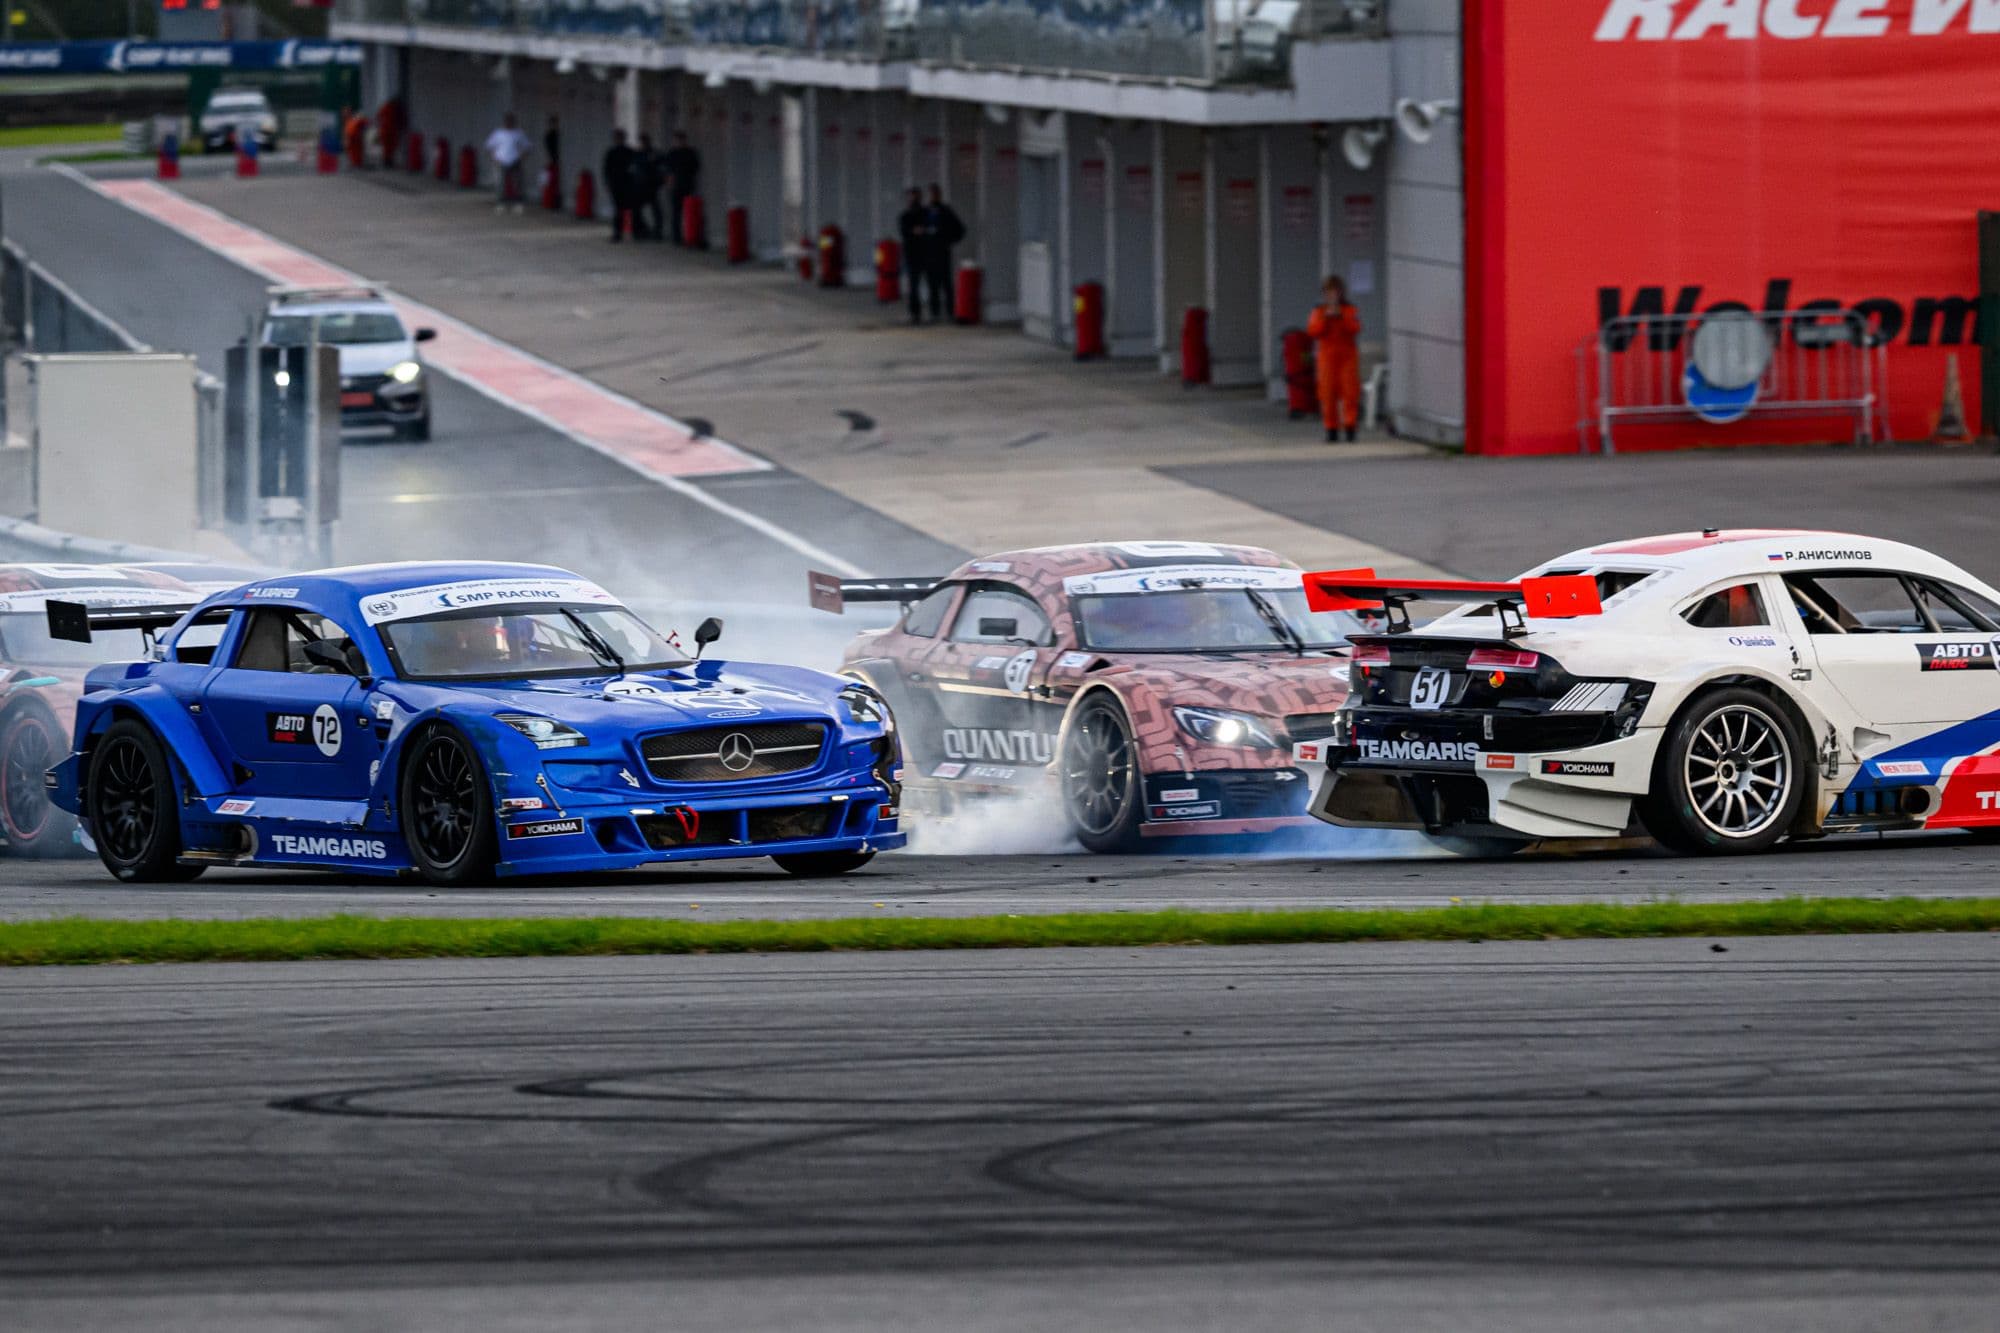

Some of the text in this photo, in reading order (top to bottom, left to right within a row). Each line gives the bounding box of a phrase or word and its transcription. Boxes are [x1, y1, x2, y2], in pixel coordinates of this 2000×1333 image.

[1597, 278, 1981, 353] Wlcom
[1785, 551, 1873, 561] Р.АНИСИМОВ
[457, 589, 561, 604] SMP RACING
[1933, 644, 1985, 658] АВТО
[1415, 671, 1445, 704] 51
[275, 715, 306, 732] АВТО
[315, 715, 339, 745] 72
[943, 729, 1059, 763] QUANTU
[1357, 739, 1480, 761] TEAMGARIS
[1562, 763, 1610, 774] YOKOHAMA
[526, 822, 578, 835] YOKOHAMA
[272, 835, 388, 860] TEAMGARIS
